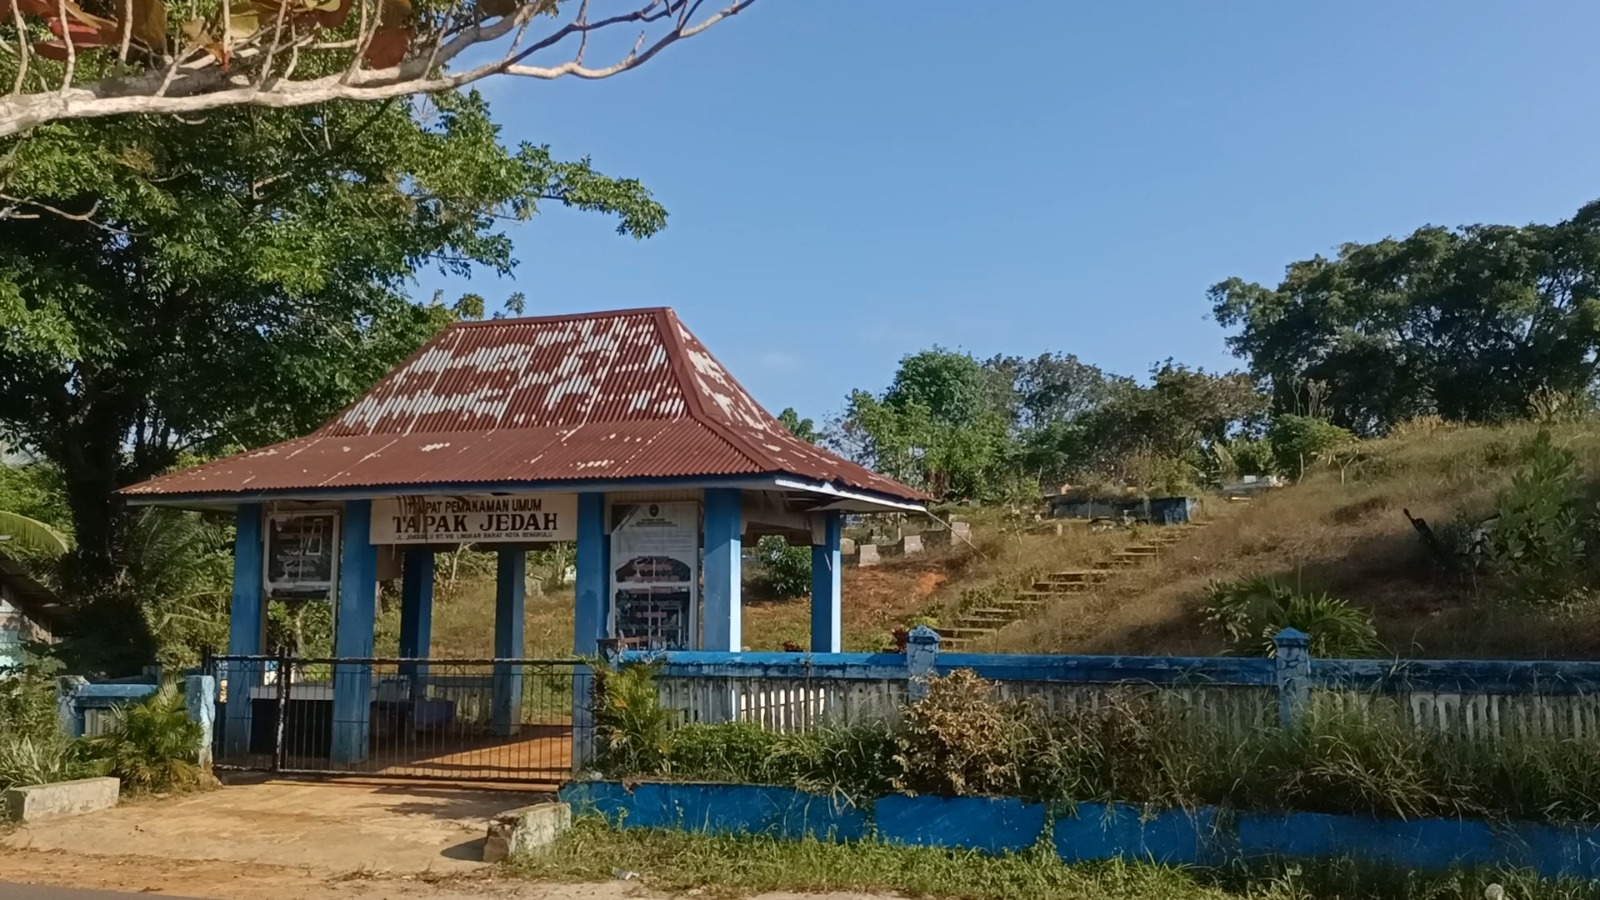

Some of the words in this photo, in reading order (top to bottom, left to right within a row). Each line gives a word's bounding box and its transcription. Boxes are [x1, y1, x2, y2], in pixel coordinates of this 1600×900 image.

[407, 501, 442, 514] TPAT
[444, 499, 508, 513] PEMAKAMAN
[512, 499, 541, 511] UMUM
[479, 513, 557, 531] JEDAH
